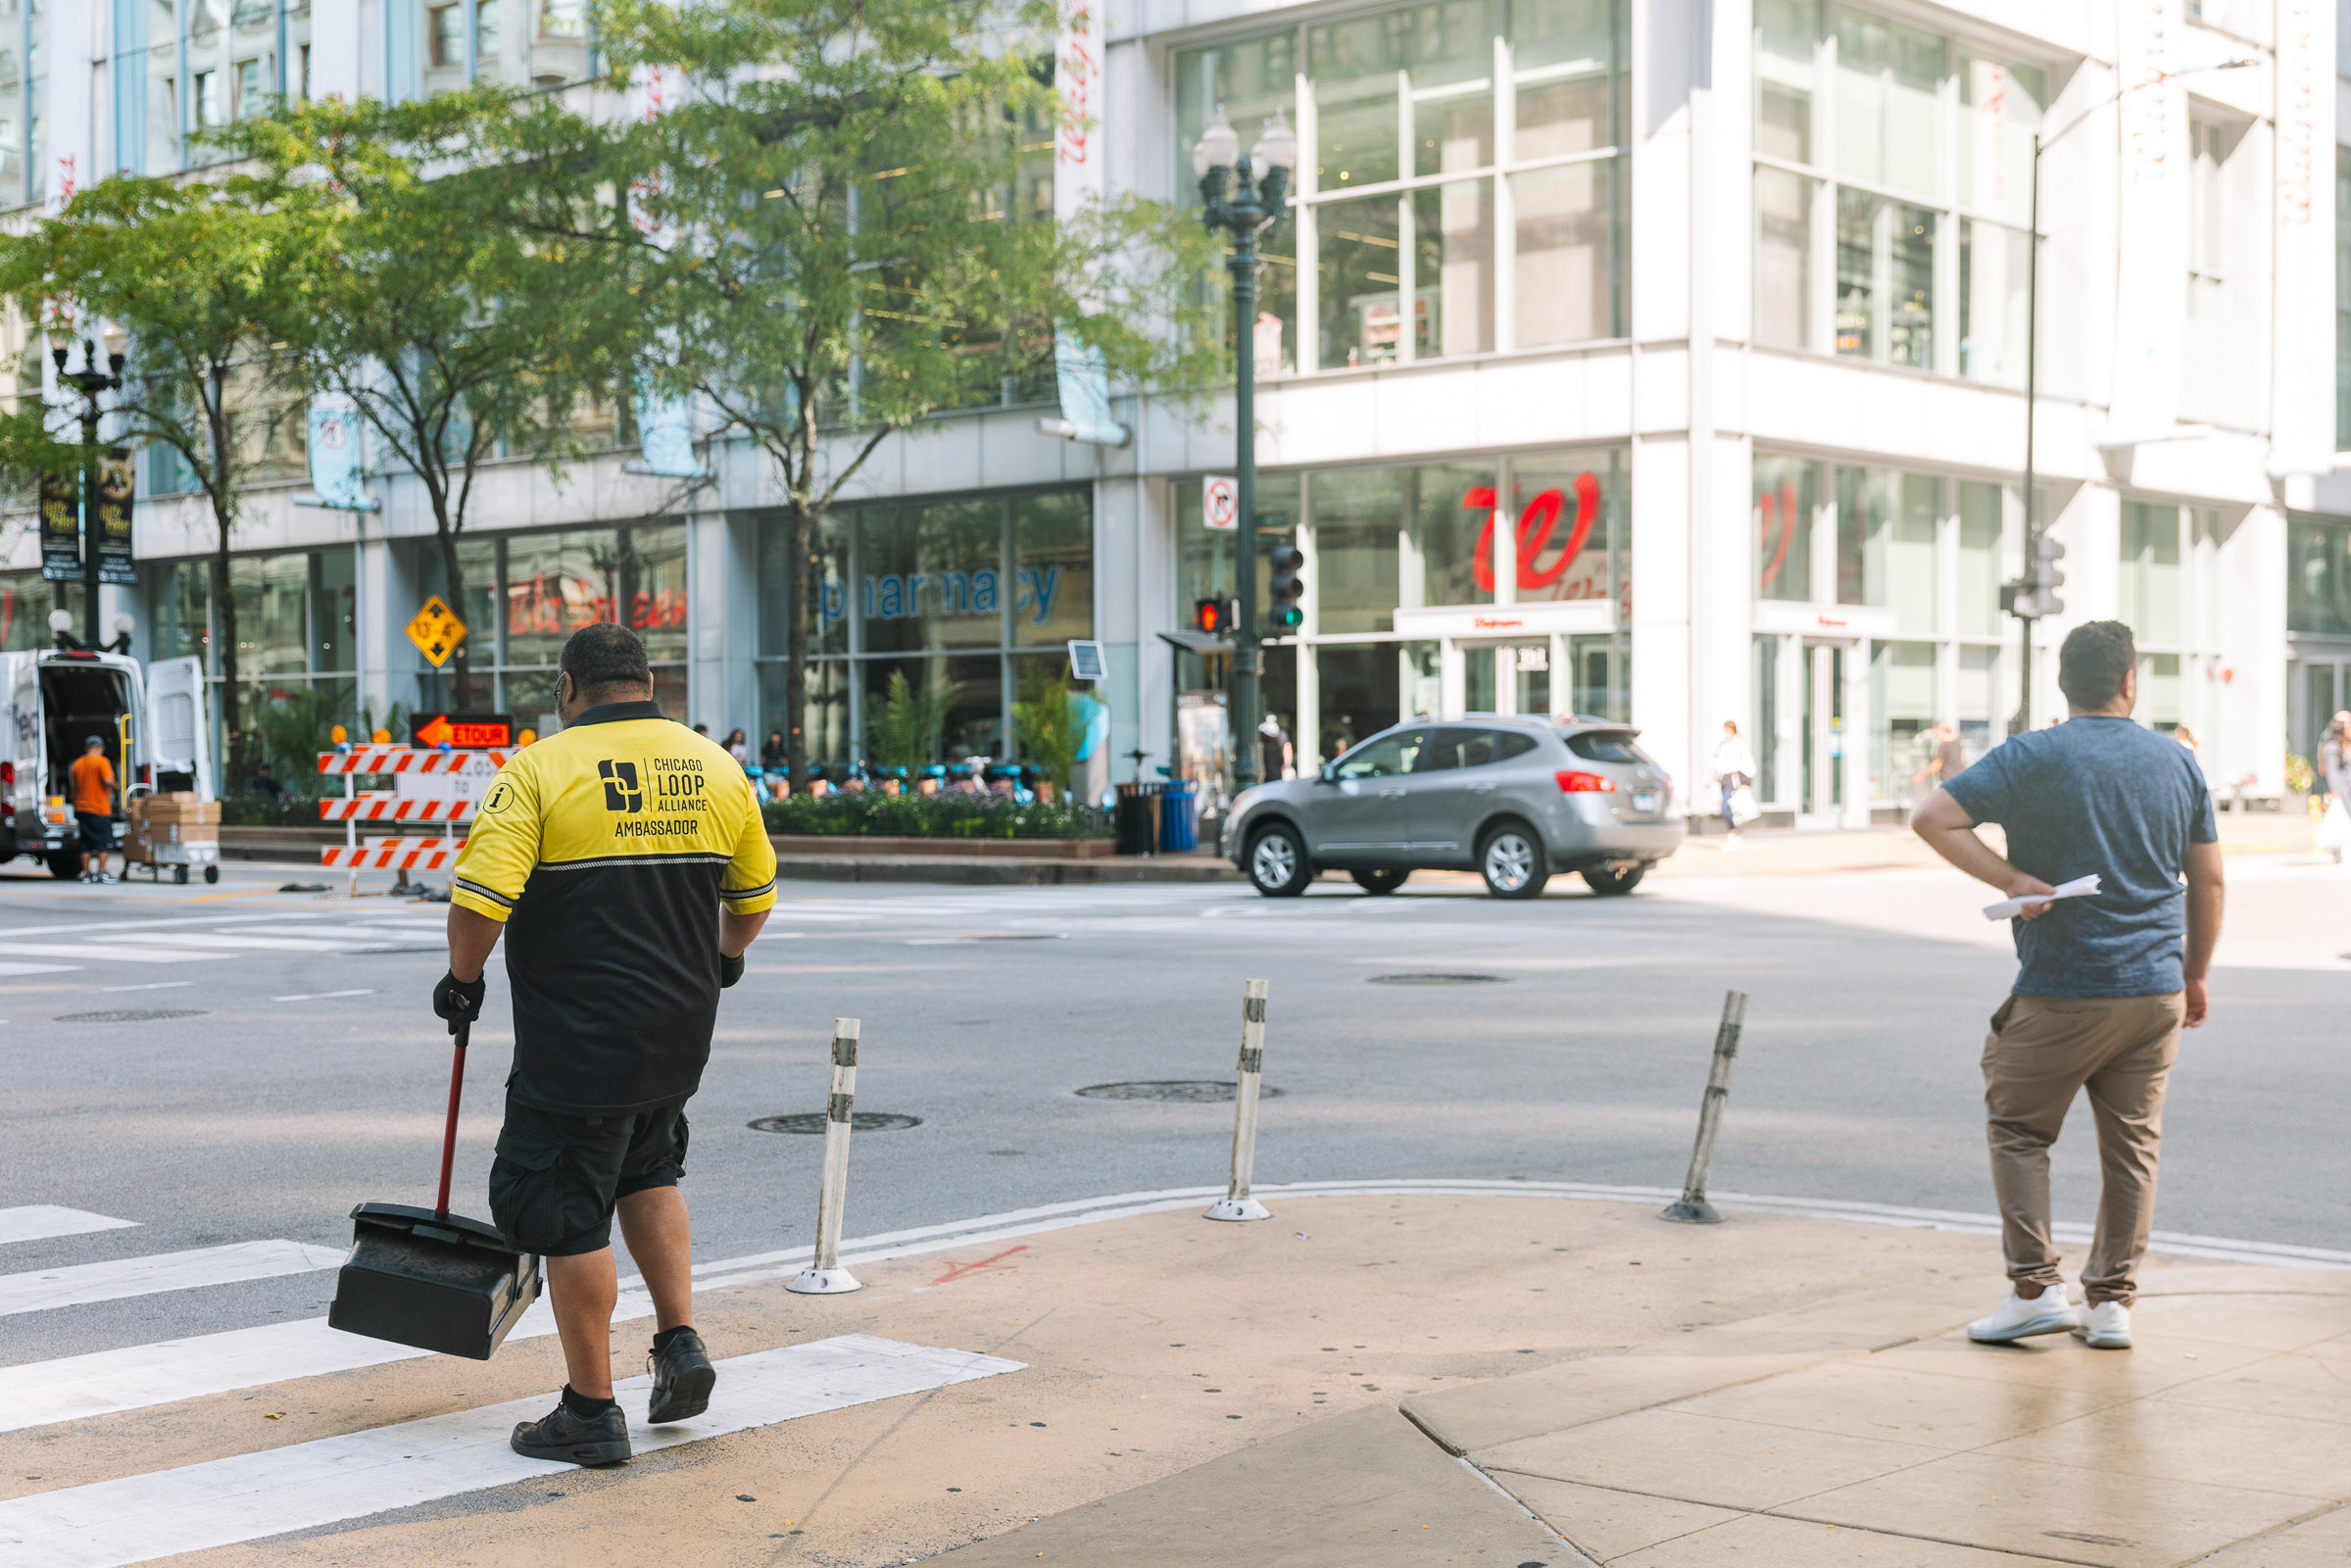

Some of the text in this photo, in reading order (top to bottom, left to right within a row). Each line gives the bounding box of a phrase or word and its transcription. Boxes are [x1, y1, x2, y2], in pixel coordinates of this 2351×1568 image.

[451, 726, 504, 743] ETOUR
[654, 758, 704, 772] CHICAGO
[658, 774, 705, 796] LOOP
[658, 799, 708, 811] ALLIANCE
[614, 819, 699, 838] AMBASSADOR
